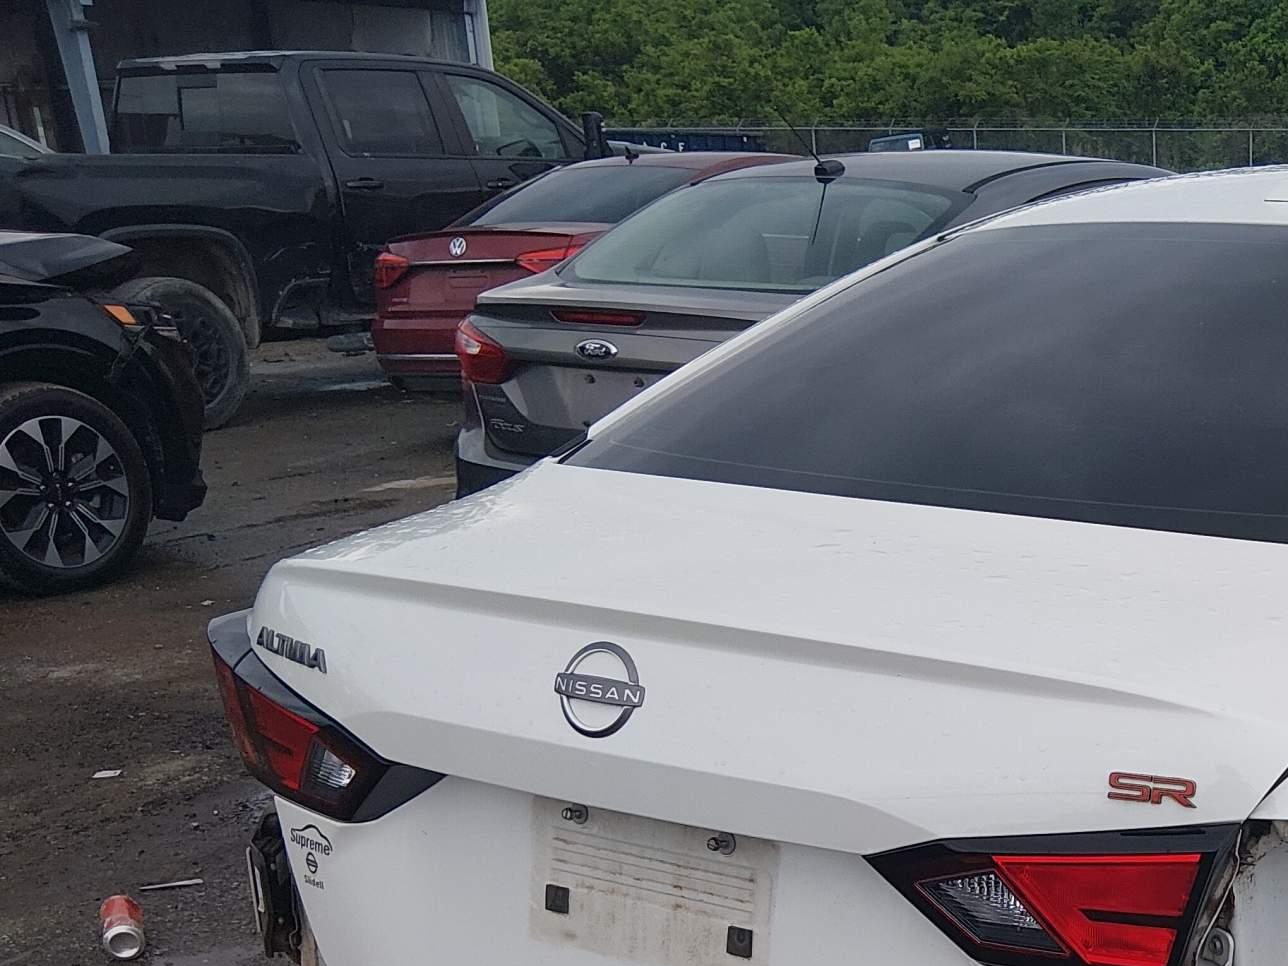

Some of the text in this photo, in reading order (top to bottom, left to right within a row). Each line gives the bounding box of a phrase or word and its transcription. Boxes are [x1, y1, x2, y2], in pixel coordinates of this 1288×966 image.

[256, 626, 327, 674] ALTIMA
[555, 676, 641, 703] NISSAN
[1107, 771, 1197, 809] SR
[290, 828, 331, 856] Supreme
